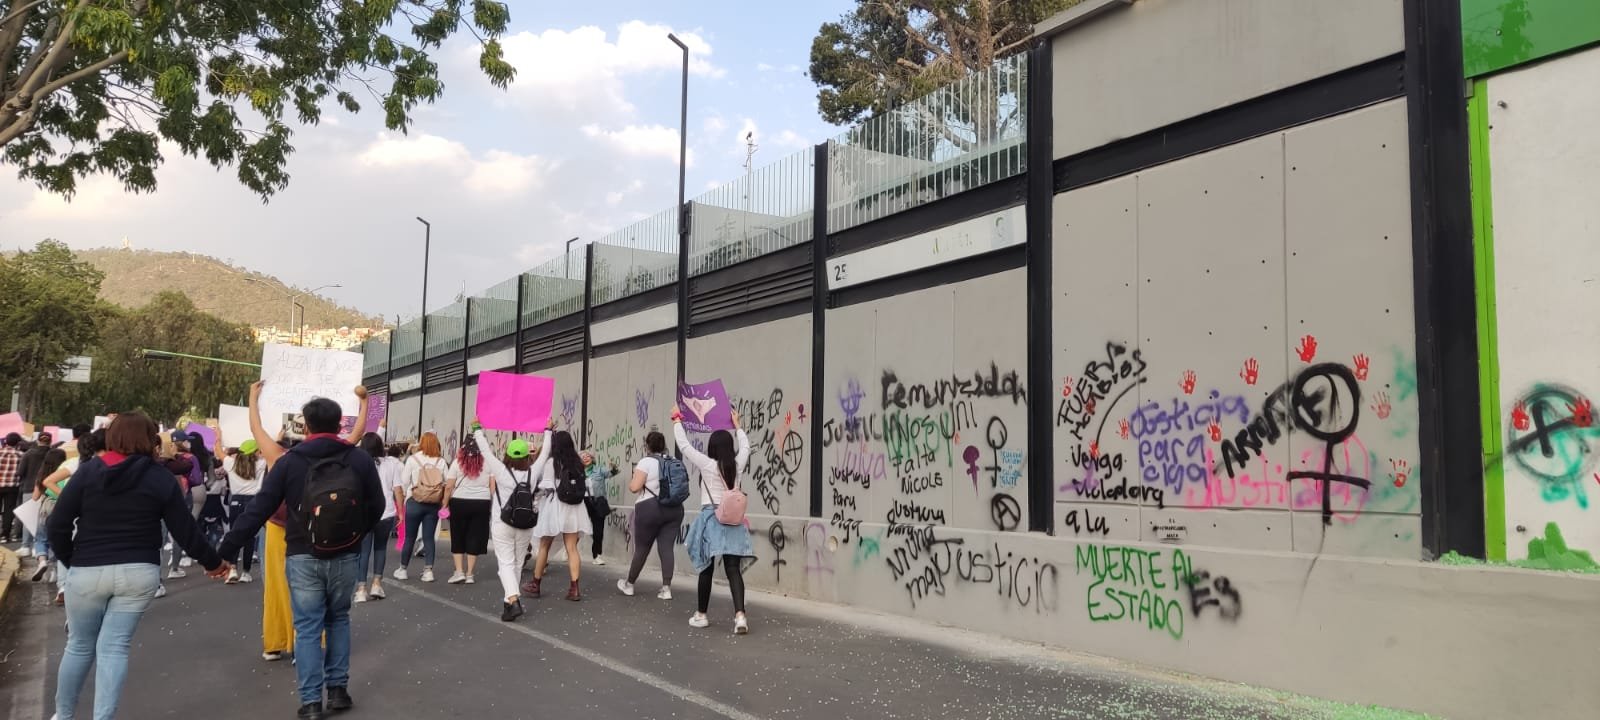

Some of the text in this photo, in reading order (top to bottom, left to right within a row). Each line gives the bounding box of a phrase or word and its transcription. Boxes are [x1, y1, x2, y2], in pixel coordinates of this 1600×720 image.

[1076, 544, 1201, 591] MUERTE AL
[1088, 577, 1184, 640] ESTADO
